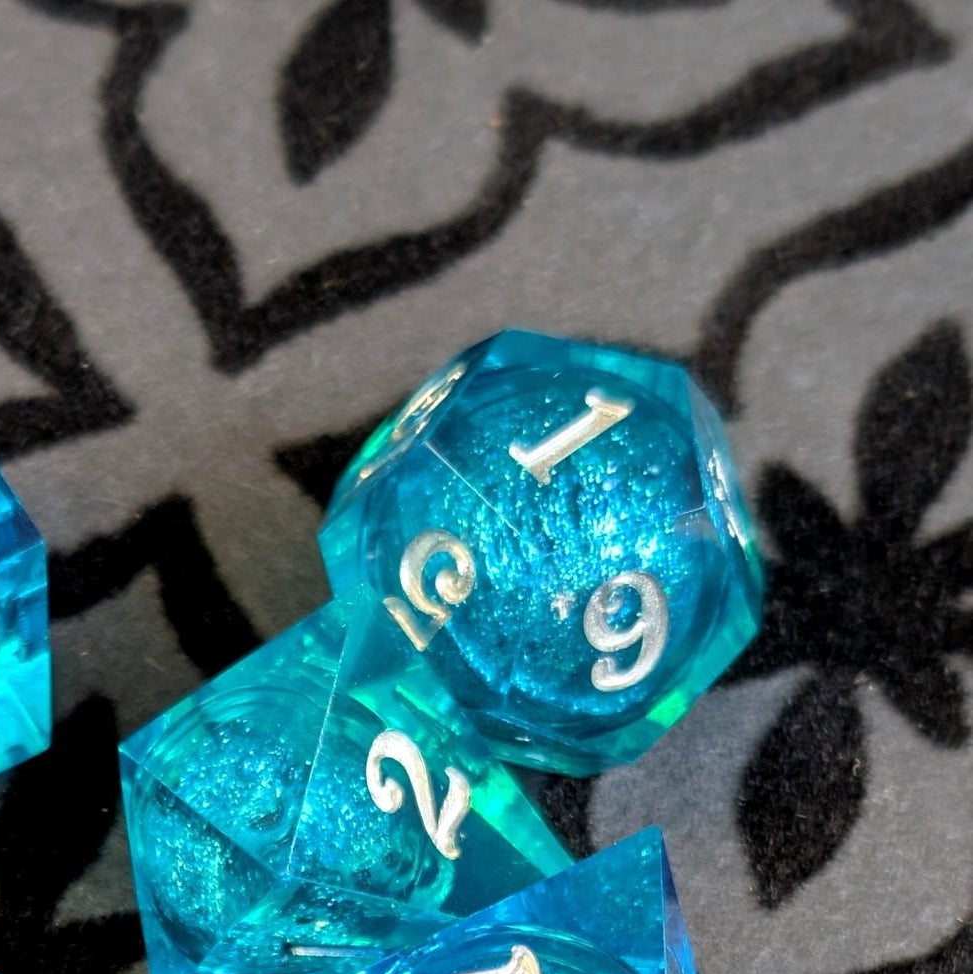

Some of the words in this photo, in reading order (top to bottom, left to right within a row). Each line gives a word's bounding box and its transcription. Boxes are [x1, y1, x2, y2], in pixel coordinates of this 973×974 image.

[509, 388, 634, 486] 1
[382, 529, 476, 652] 5
[366, 729, 470, 860] 2
